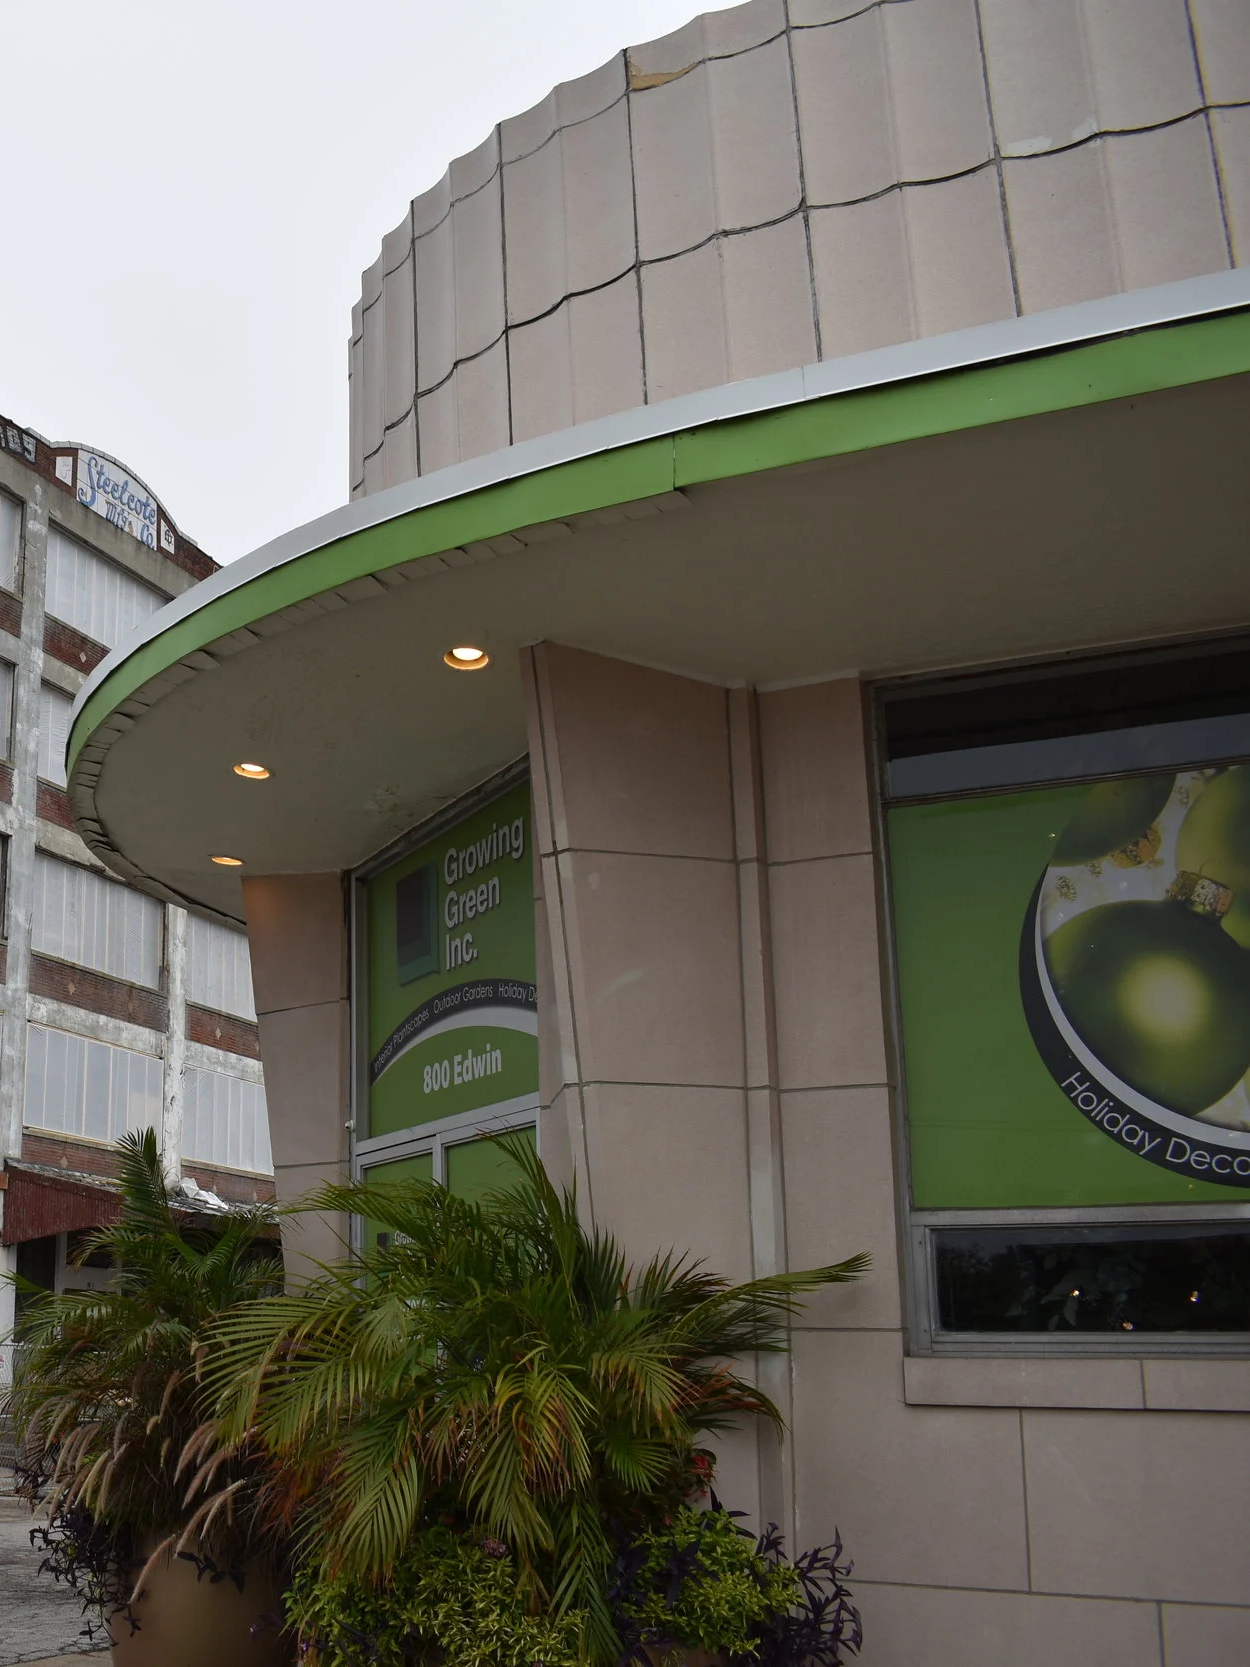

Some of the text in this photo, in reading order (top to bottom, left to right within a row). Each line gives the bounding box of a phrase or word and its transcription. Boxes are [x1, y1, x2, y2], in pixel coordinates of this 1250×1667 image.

[78, 456, 156, 526] Steelcote
[444, 817, 524, 885] Growing
[444, 876, 500, 929] Green
[445, 932, 478, 971] Inc.
[373, 981, 538, 1074] Interior Plantscapes Outdoor Gardens Holiday De
[423, 1042, 502, 1094] 800 Edwin
[1061, 1071, 1161, 1155] Holiday
